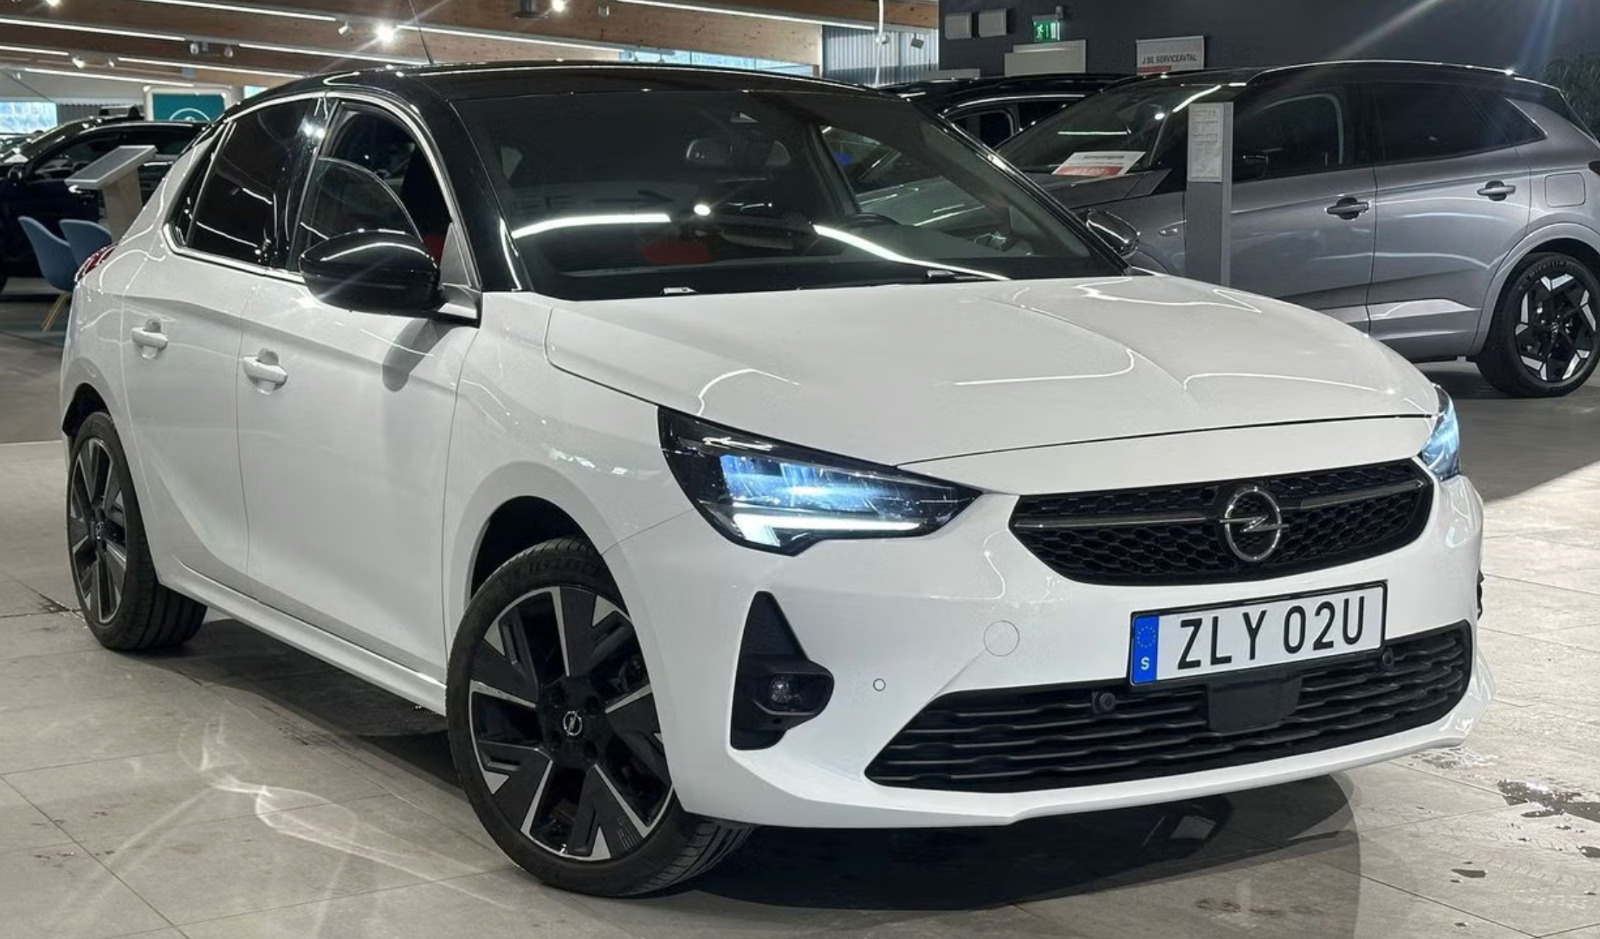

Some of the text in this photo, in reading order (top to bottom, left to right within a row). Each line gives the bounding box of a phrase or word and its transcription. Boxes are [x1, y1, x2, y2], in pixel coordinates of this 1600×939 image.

[1177, 595, 1365, 670] ZLY 02U
[1140, 656, 1150, 671] S
